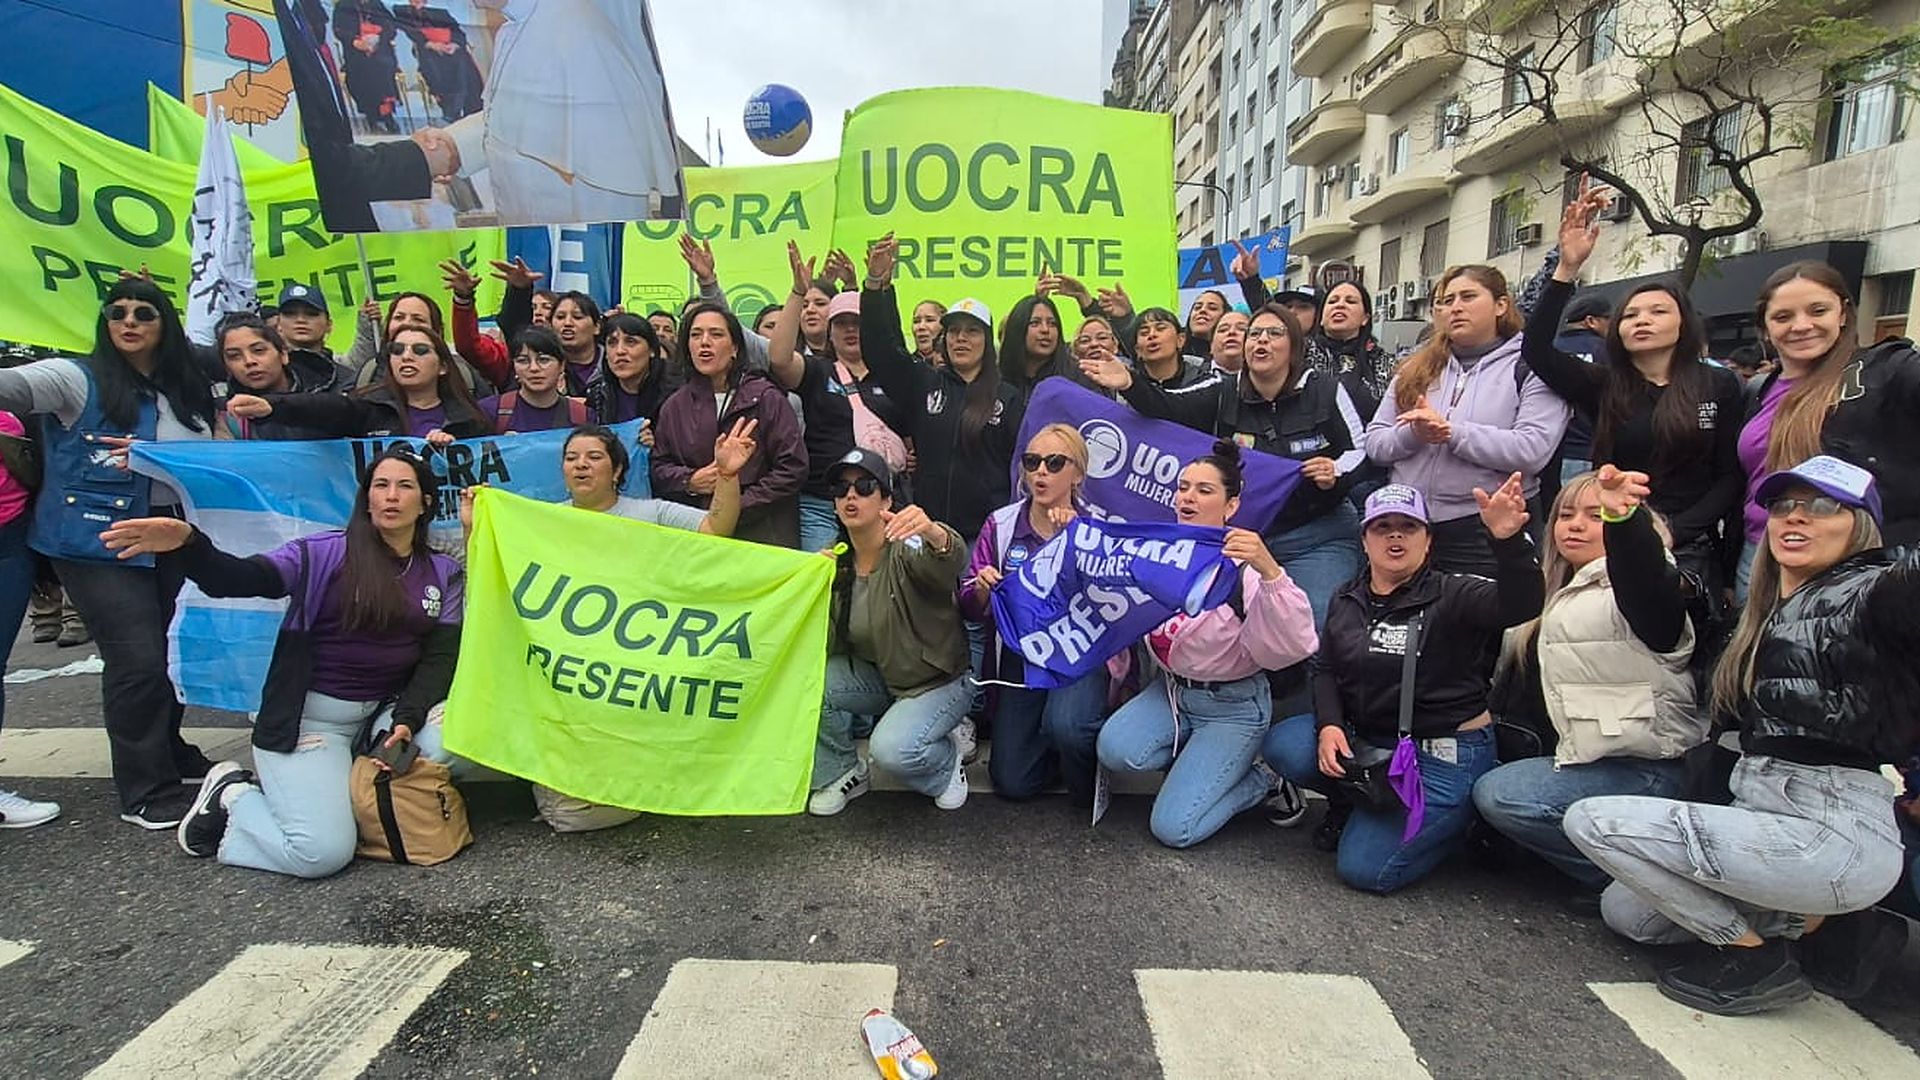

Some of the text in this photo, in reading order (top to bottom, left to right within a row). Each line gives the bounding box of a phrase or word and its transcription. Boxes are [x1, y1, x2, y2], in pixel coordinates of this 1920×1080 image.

[5, 134, 344, 258] UOR
[862, 142, 1125, 217] UOCRA
[867, 236, 1124, 279] RESENTE
[512, 561, 752, 660] UOCRA
